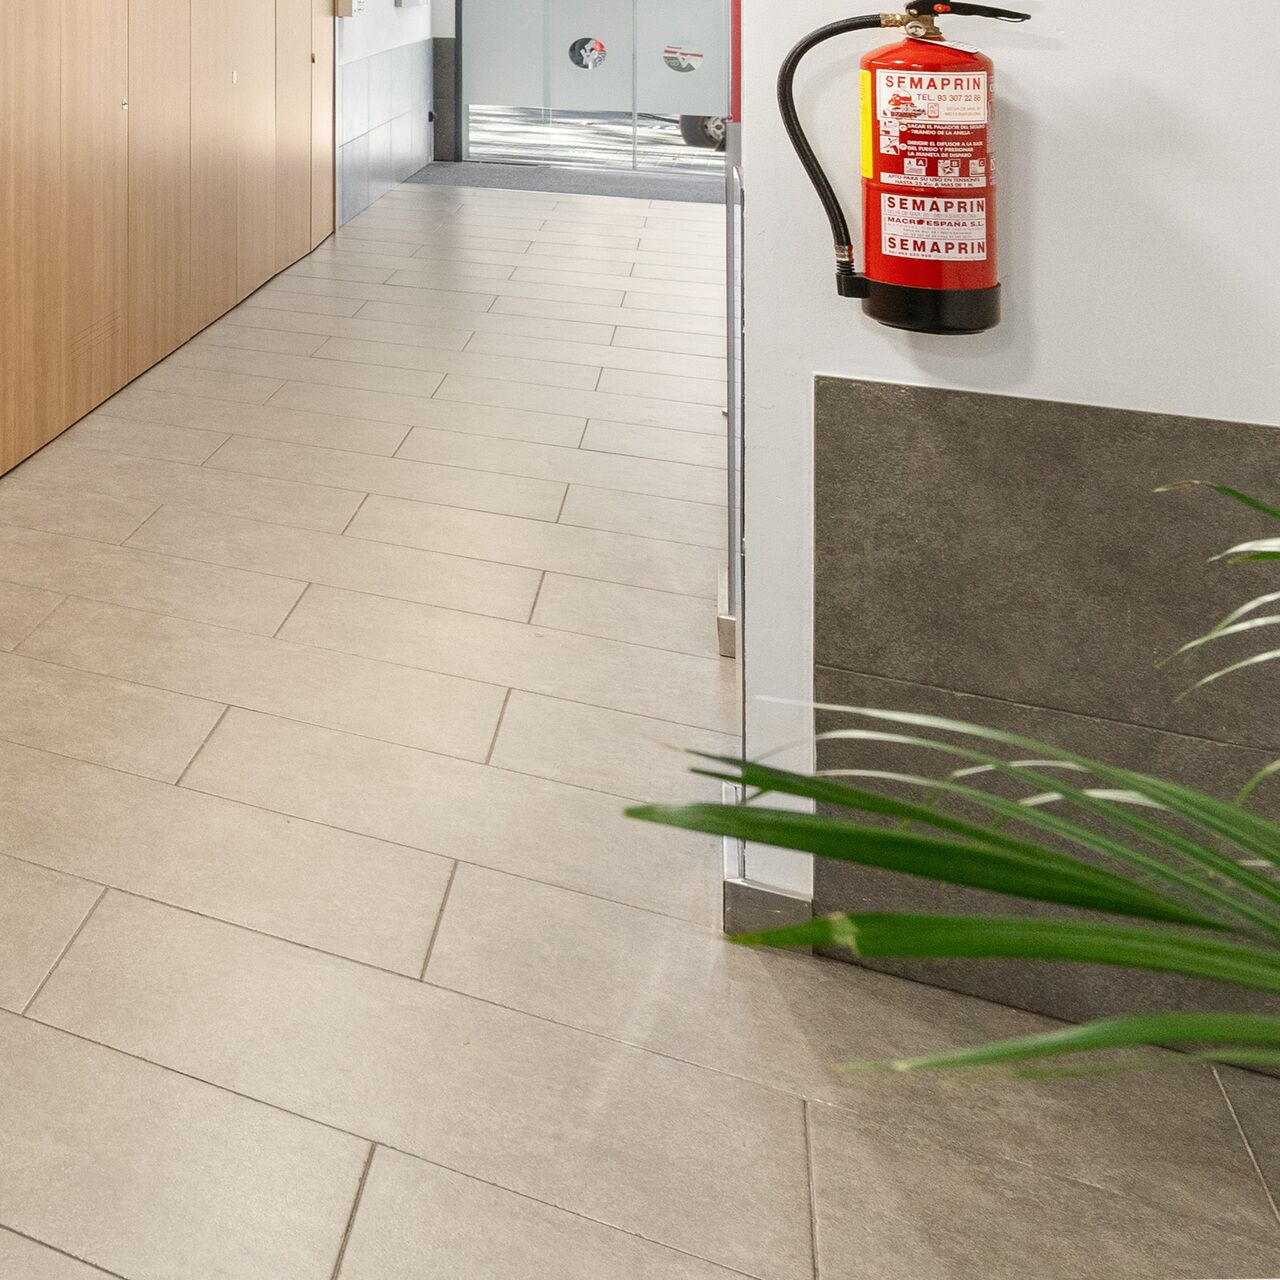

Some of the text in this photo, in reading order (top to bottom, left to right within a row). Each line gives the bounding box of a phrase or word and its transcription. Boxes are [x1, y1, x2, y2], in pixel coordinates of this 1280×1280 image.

[885, 75, 981, 90] SEMAPRIN
[937, 94, 947, 102] 93
[887, 196, 984, 212] SEMAPRIN
[888, 237, 985, 254] SEMAPRIN
